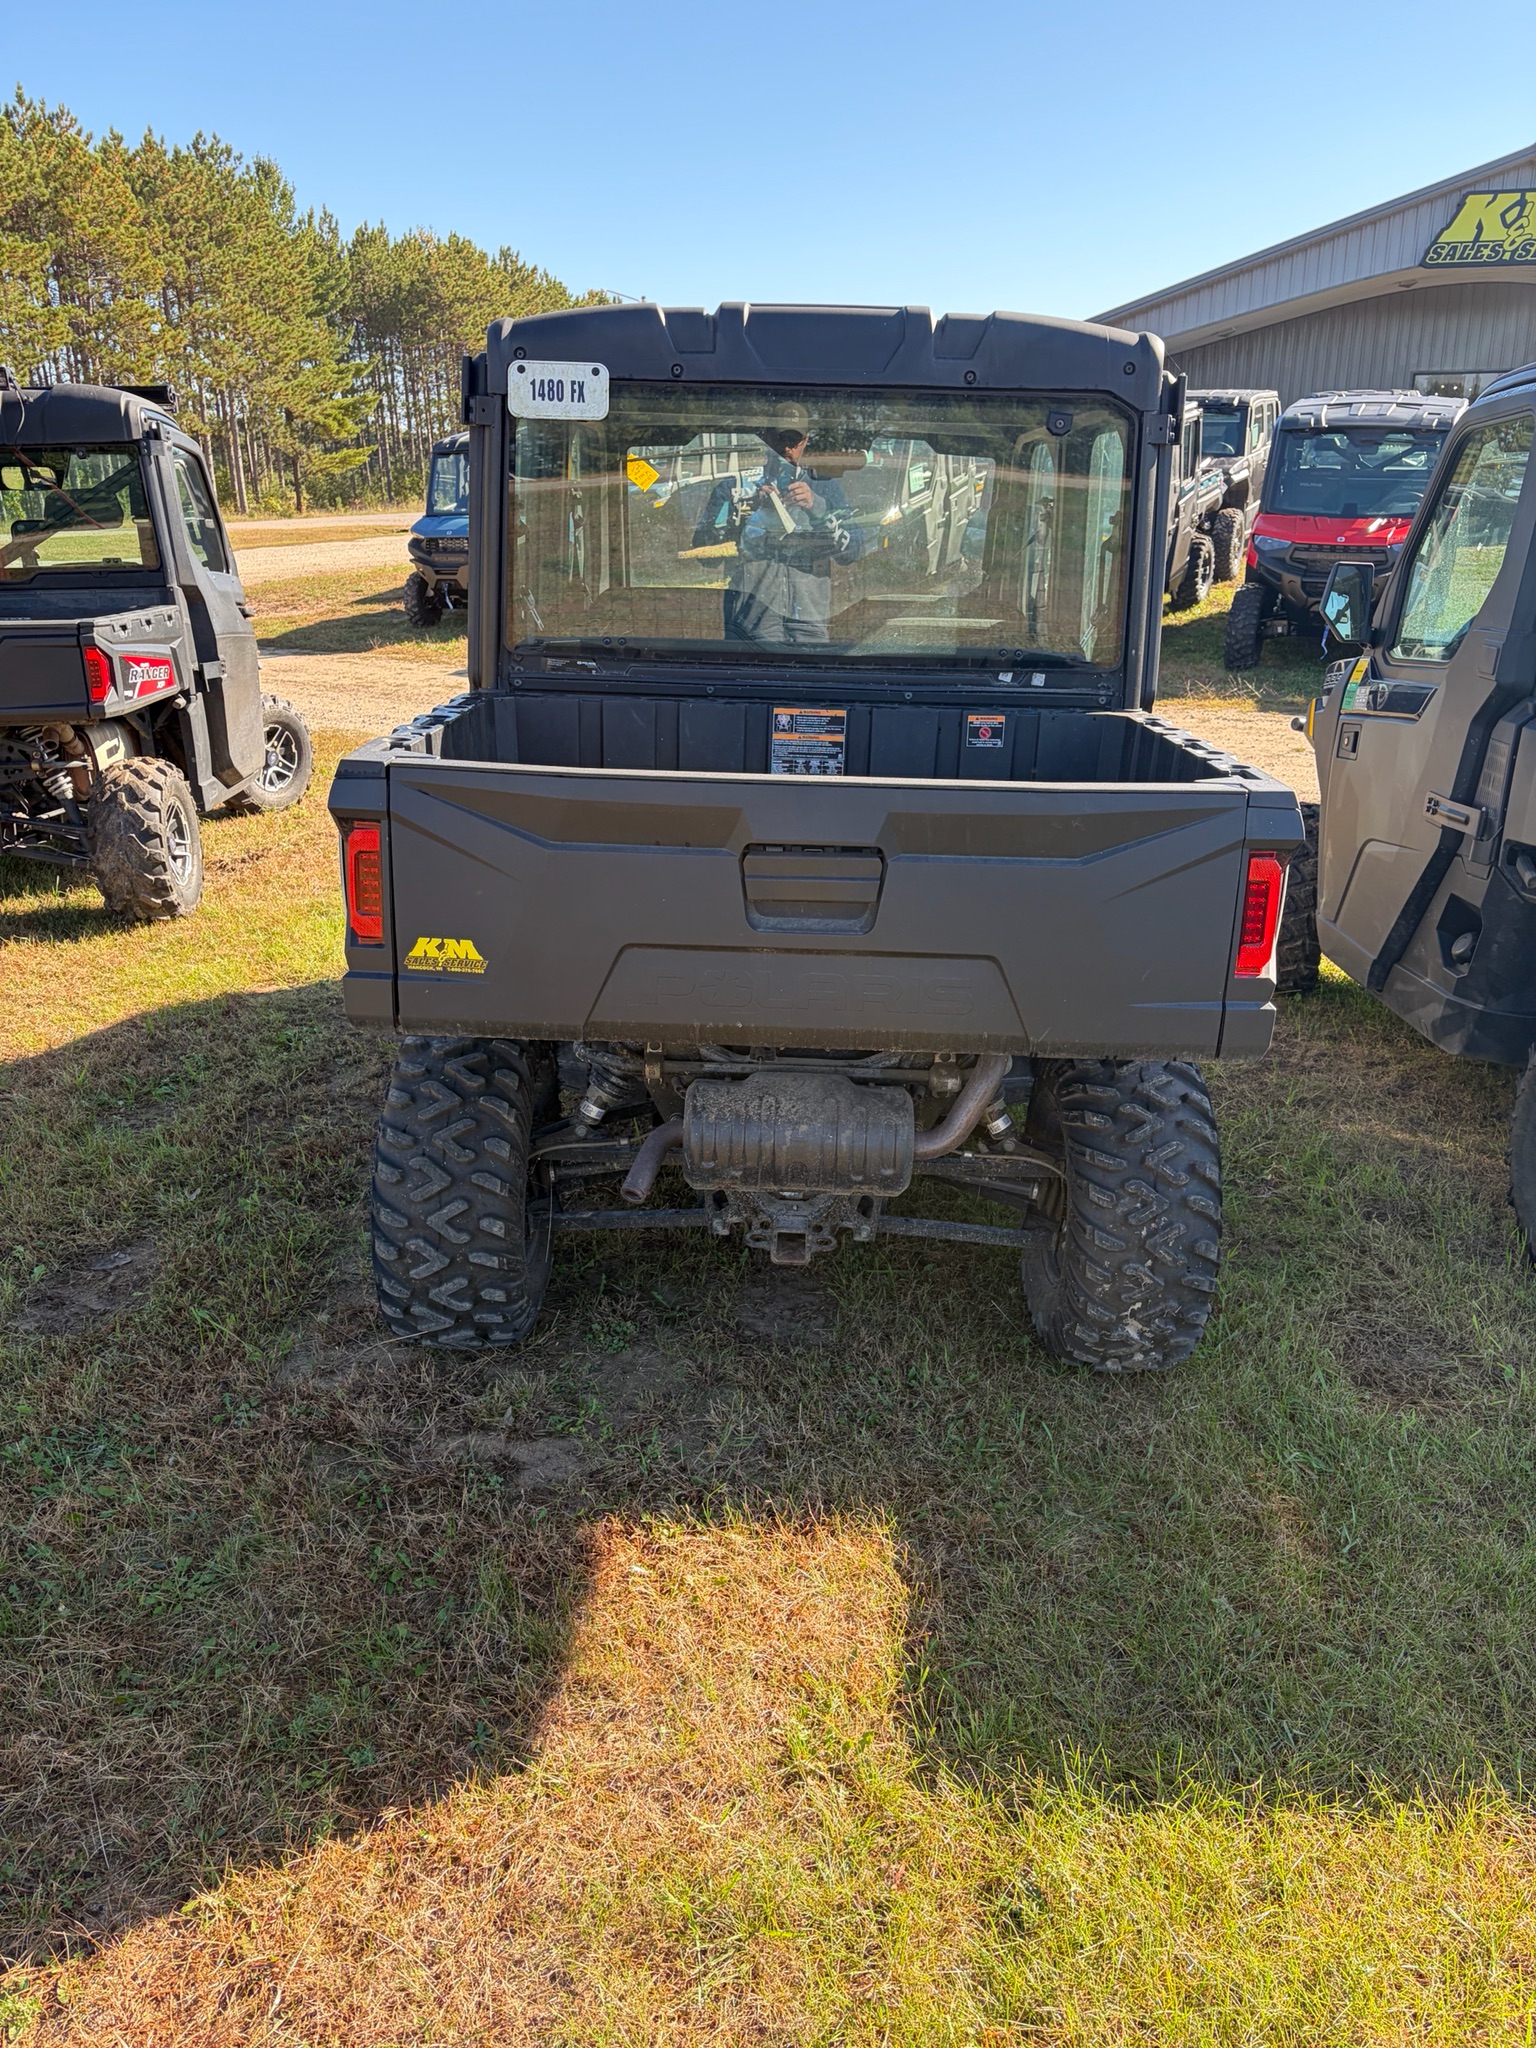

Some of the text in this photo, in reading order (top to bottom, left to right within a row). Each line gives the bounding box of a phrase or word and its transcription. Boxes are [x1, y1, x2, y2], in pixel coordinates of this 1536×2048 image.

[1425, 241, 1504, 263] SALES
[529, 378, 585, 403] 1480 FX
[129, 665, 170, 683] RANGER
[403, 956, 489, 970] SALES SERVICE
[643, 970, 974, 1015] POLARIS
